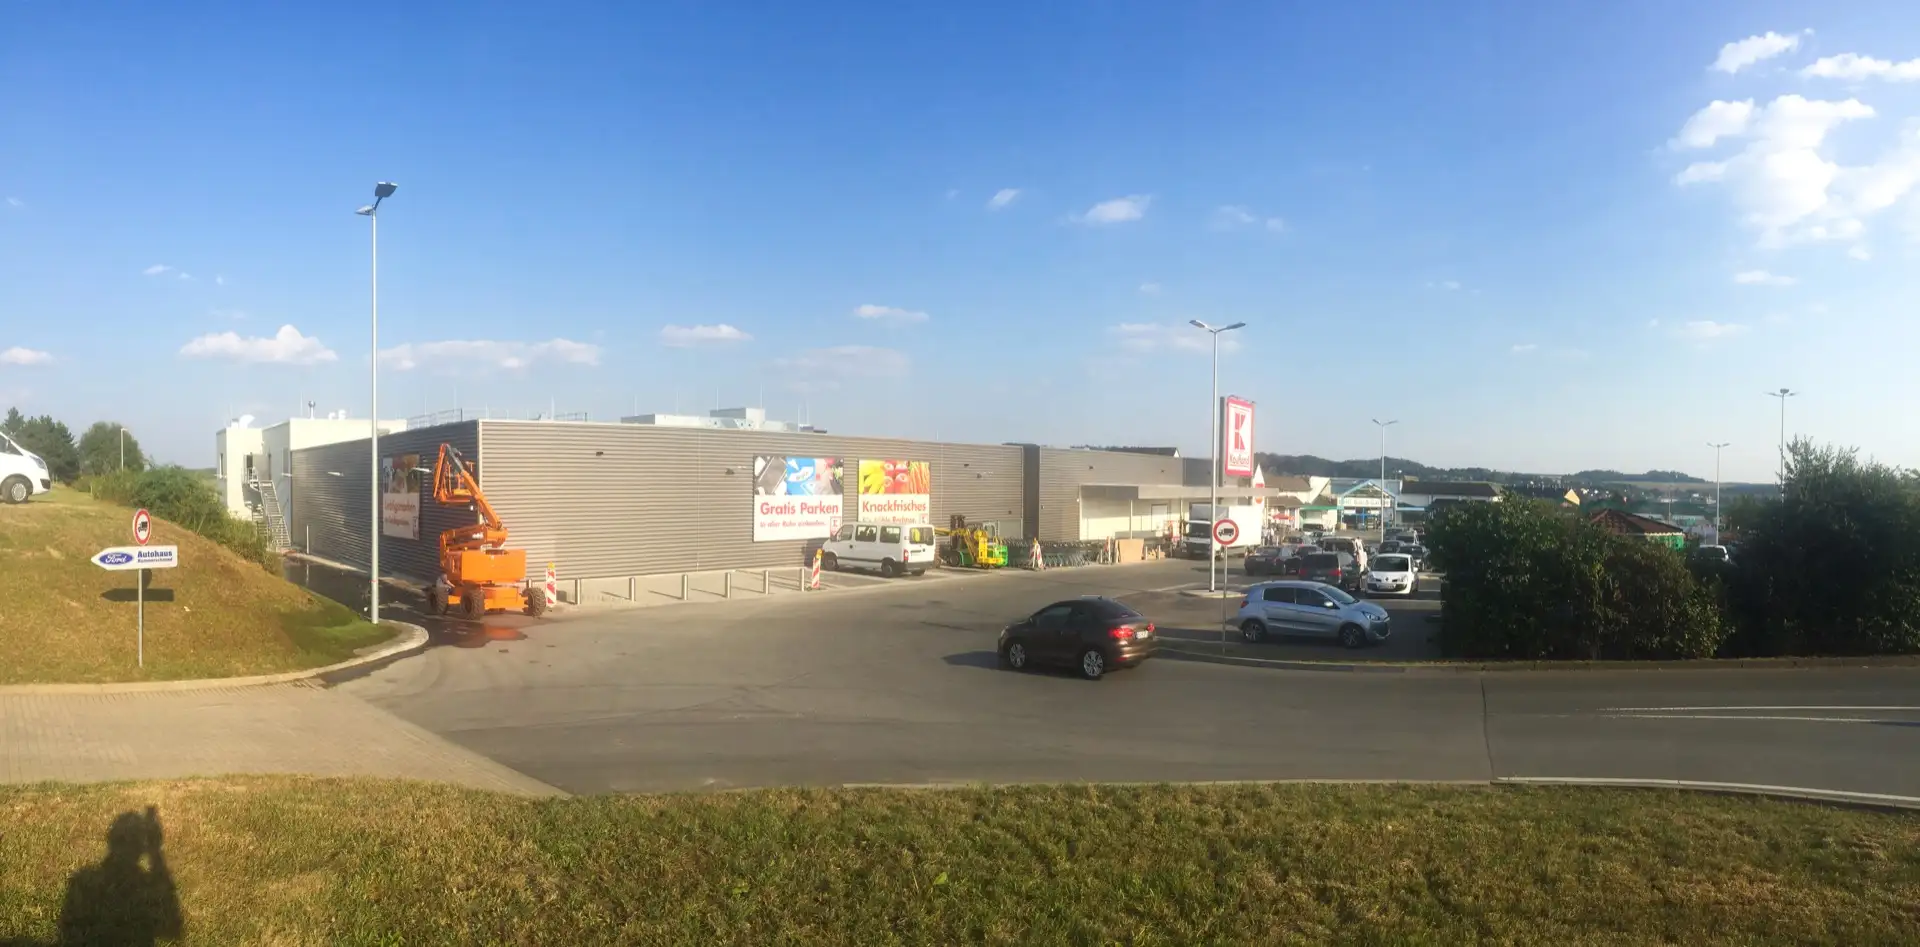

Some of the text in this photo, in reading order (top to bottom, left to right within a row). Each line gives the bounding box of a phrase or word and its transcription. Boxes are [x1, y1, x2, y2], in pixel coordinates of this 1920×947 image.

[1234, 412, 1246, 450] K
[760, 500, 839, 515] Gratis Parken
[862, 500, 926, 512] Knackfrisches
[105, 553, 127, 563] Ford
[137, 550, 172, 558] Autohaus
